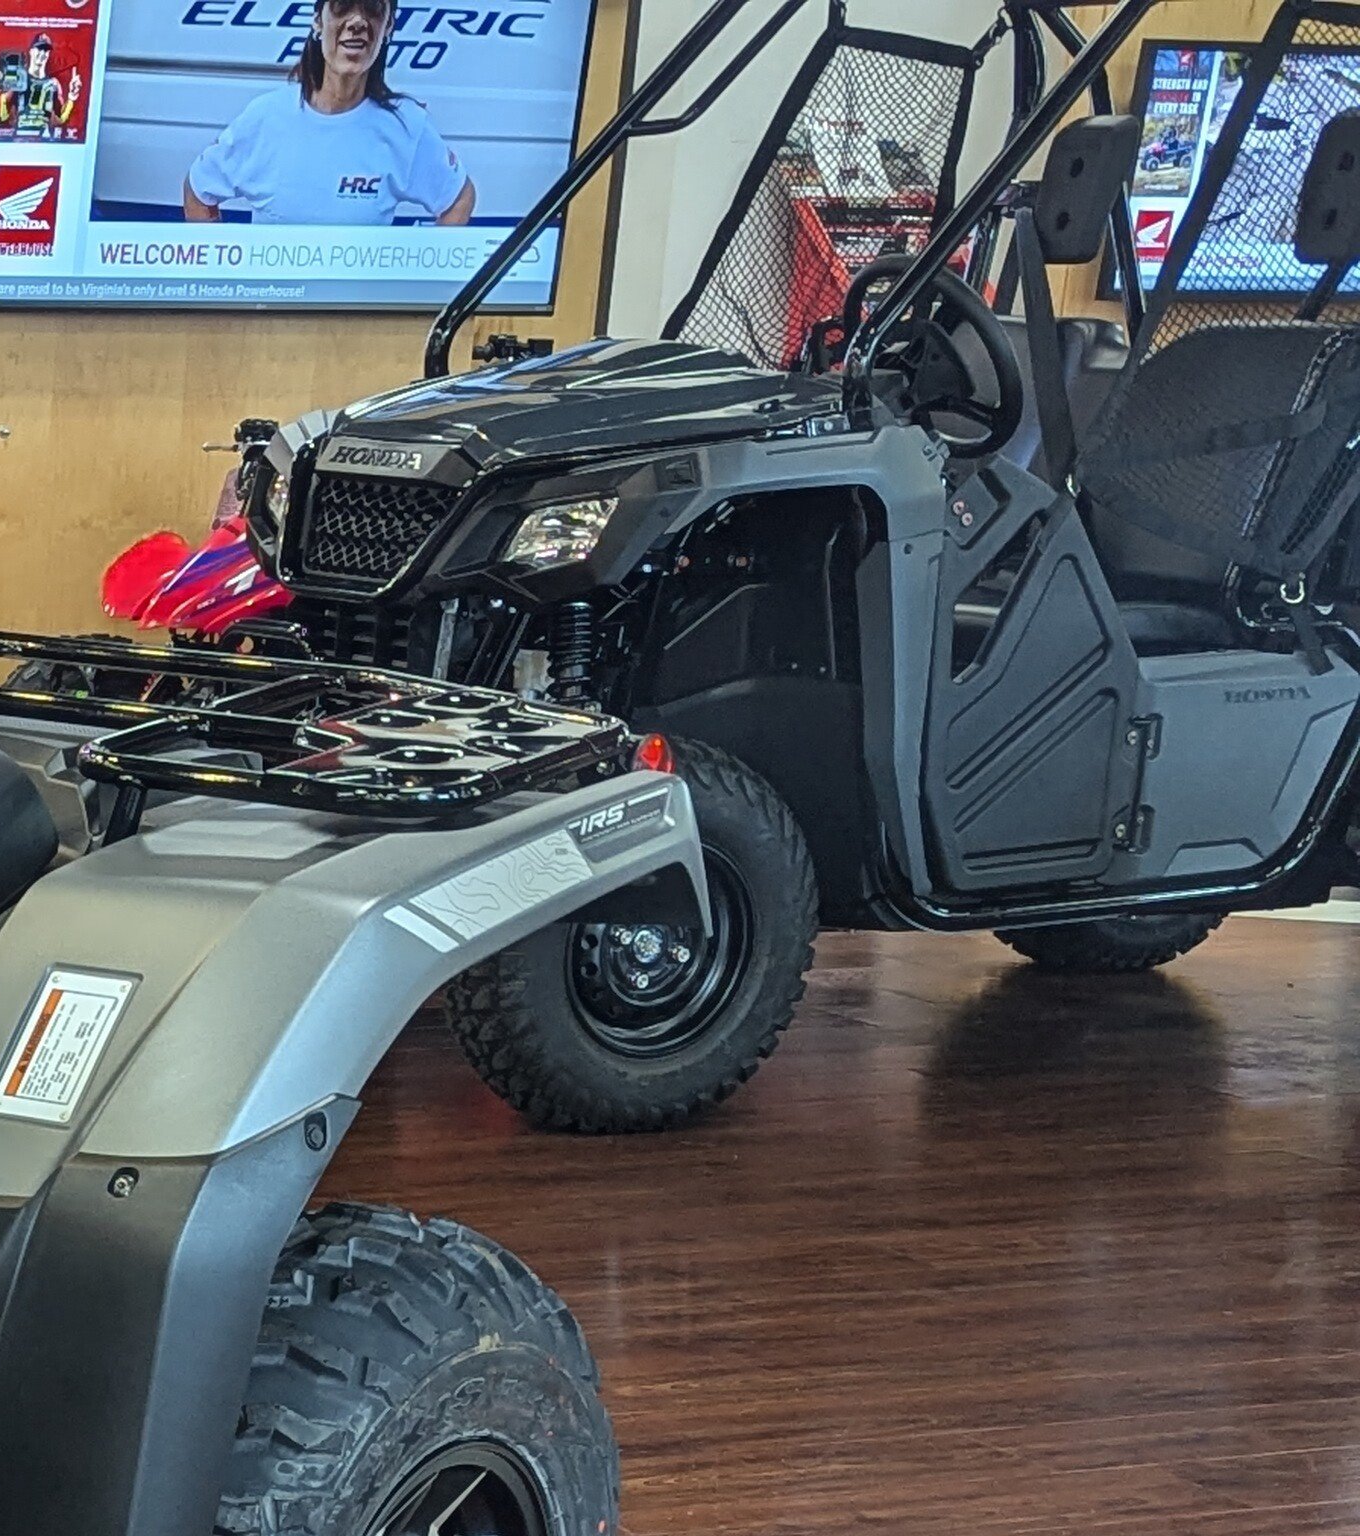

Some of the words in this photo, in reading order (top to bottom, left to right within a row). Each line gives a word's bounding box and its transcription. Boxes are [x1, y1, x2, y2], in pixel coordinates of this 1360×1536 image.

[181, 0, 545, 38] ELETRIC
[338, 176, 382, 194] HRC
[100, 243, 210, 266] WELCOME
[215, 244, 243, 266] TO
[249, 245, 323, 267] HONDA
[330, 246, 475, 269] POWERHOUSE
[18, 283, 50, 297] proud
[52, 284, 64, 295] to
[65, 283, 80, 295] be
[81, 283, 130, 298] Virginia's
[133, 283, 156, 298] only
[157, 284, 187, 297] Level
[189, 284, 197, 297] 5
[198, 285, 233, 297] Honda
[236, 285, 305, 297] Powerhouse!
[329, 446, 423, 470] HONDA
[1224, 687, 1311, 703] HONDA
[579, 802, 626, 836] IRS
